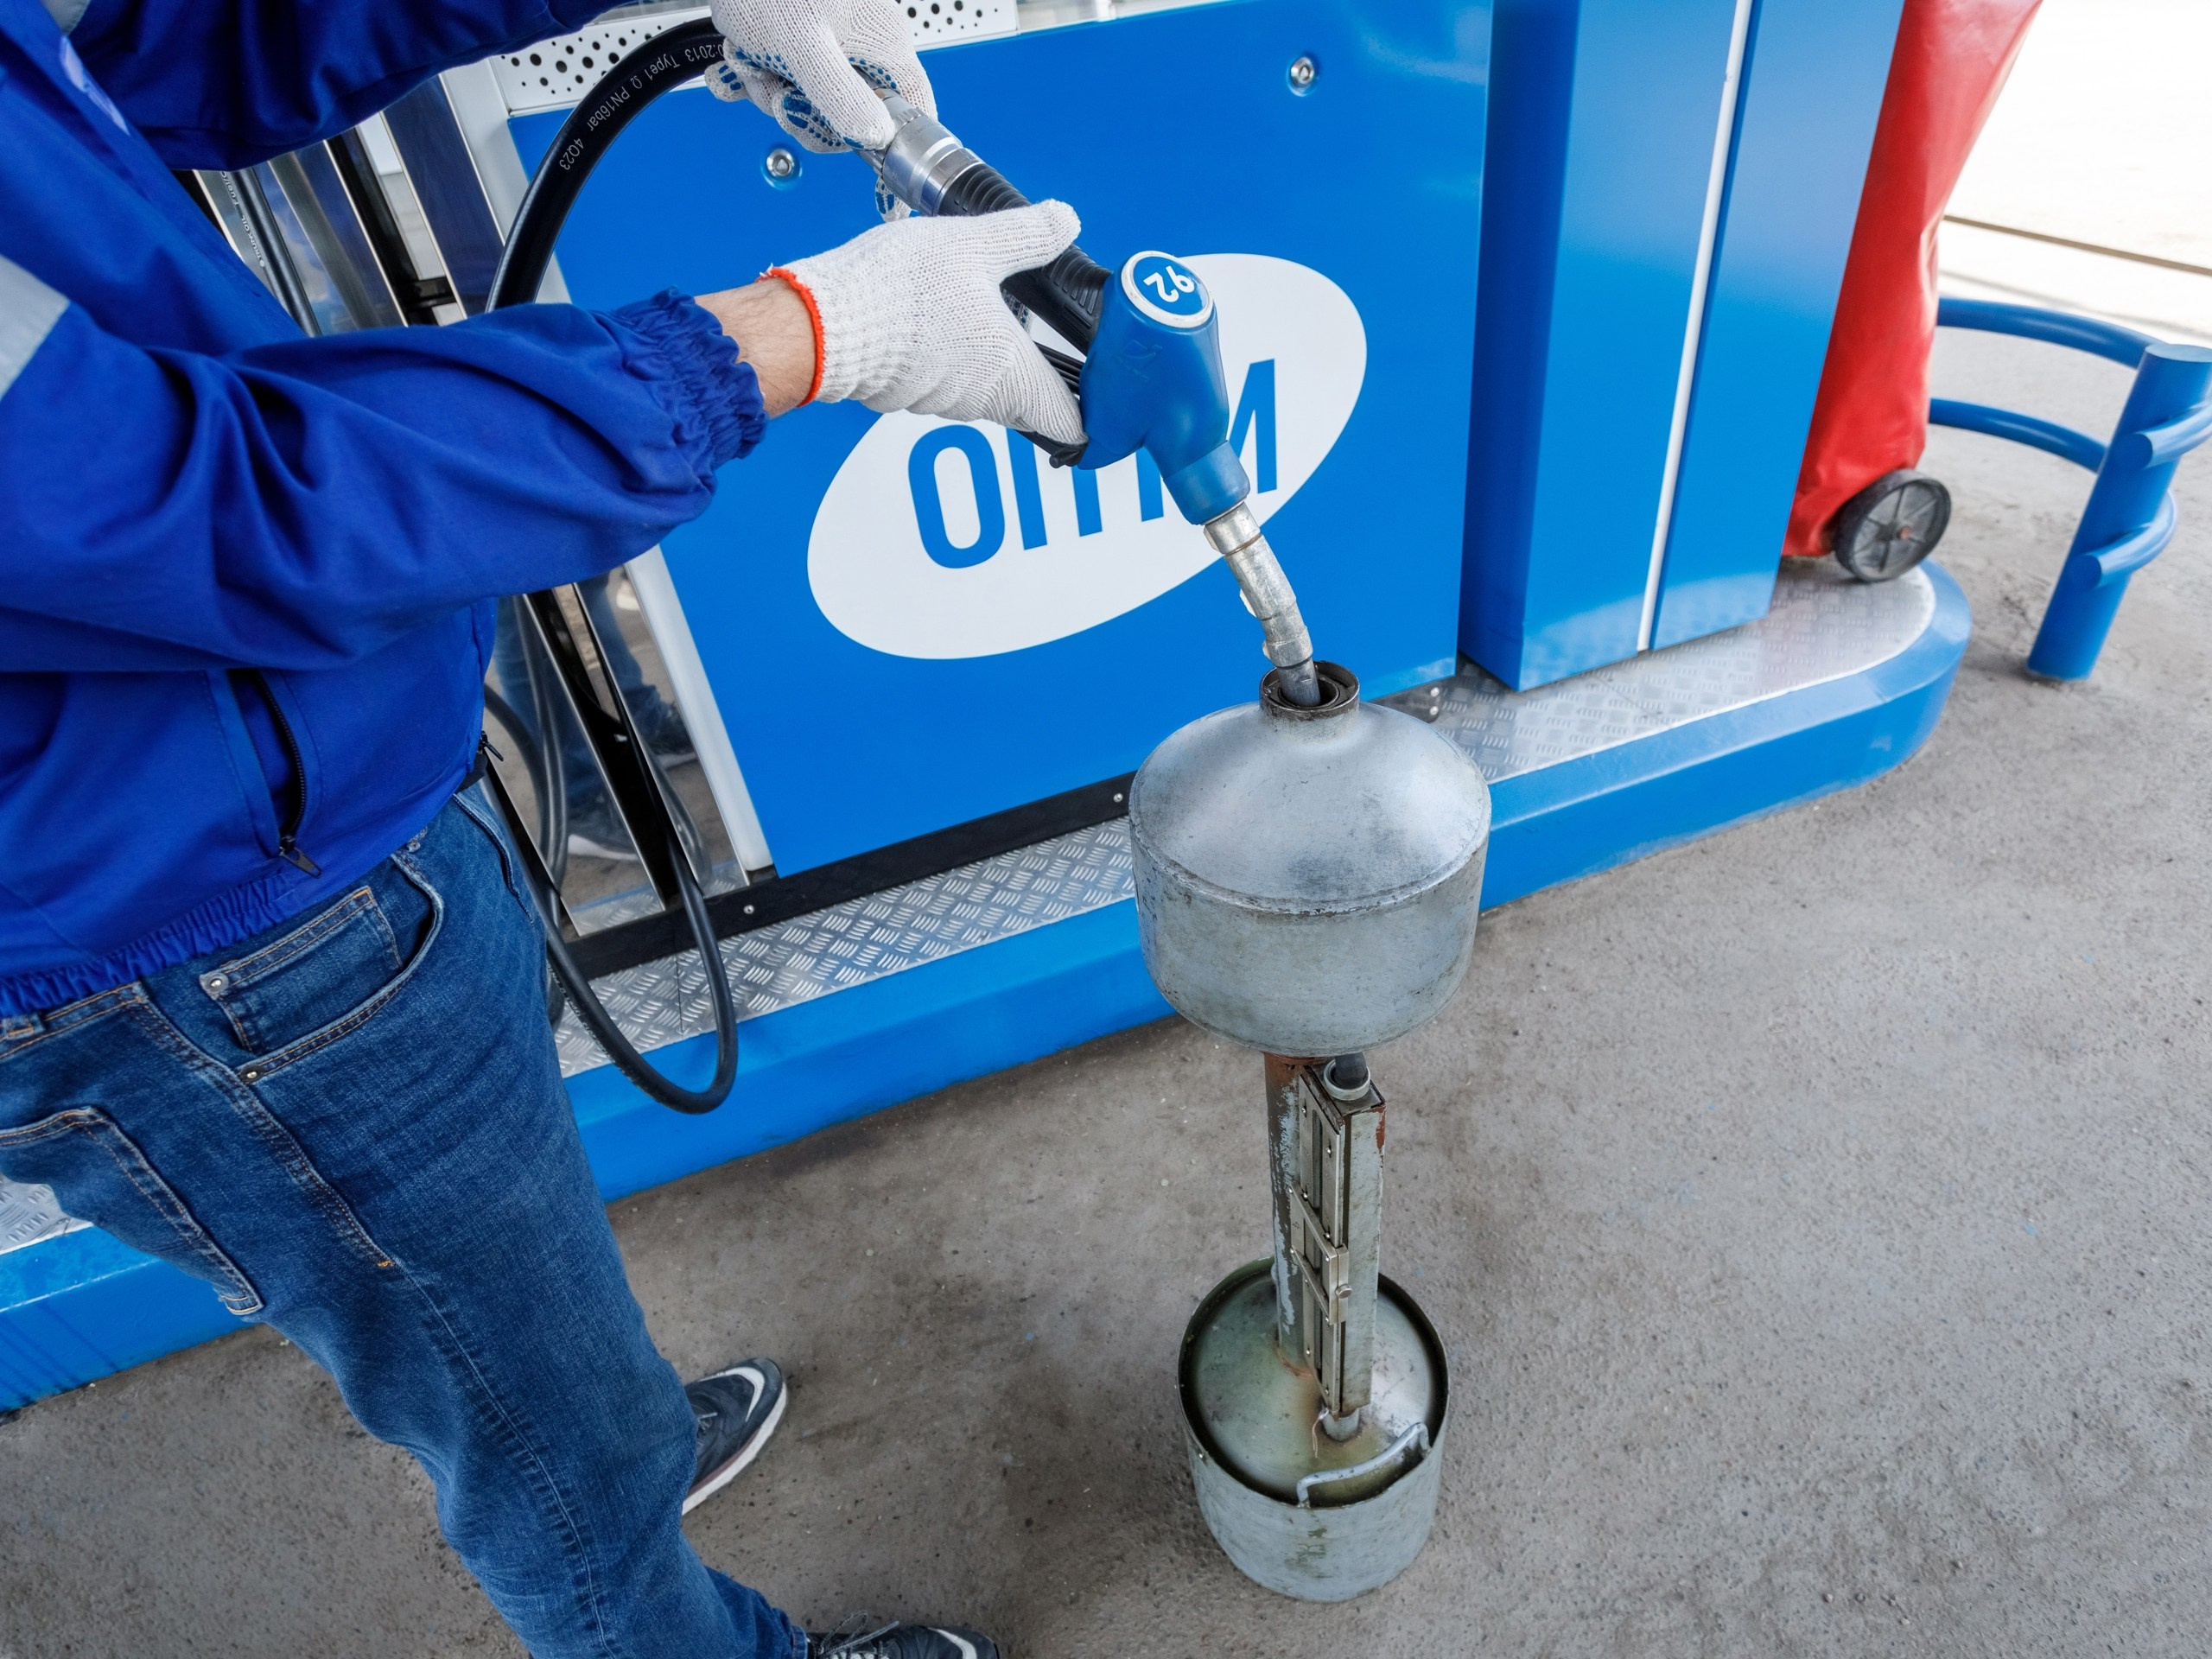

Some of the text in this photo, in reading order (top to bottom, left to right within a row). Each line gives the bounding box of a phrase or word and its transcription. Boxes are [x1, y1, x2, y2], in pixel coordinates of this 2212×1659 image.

[645, 54, 680, 80] Type1
[587, 86, 630, 131] PN16bar
[559, 138, 584, 170] 4Q23
[1143, 265, 1194, 302] 92
